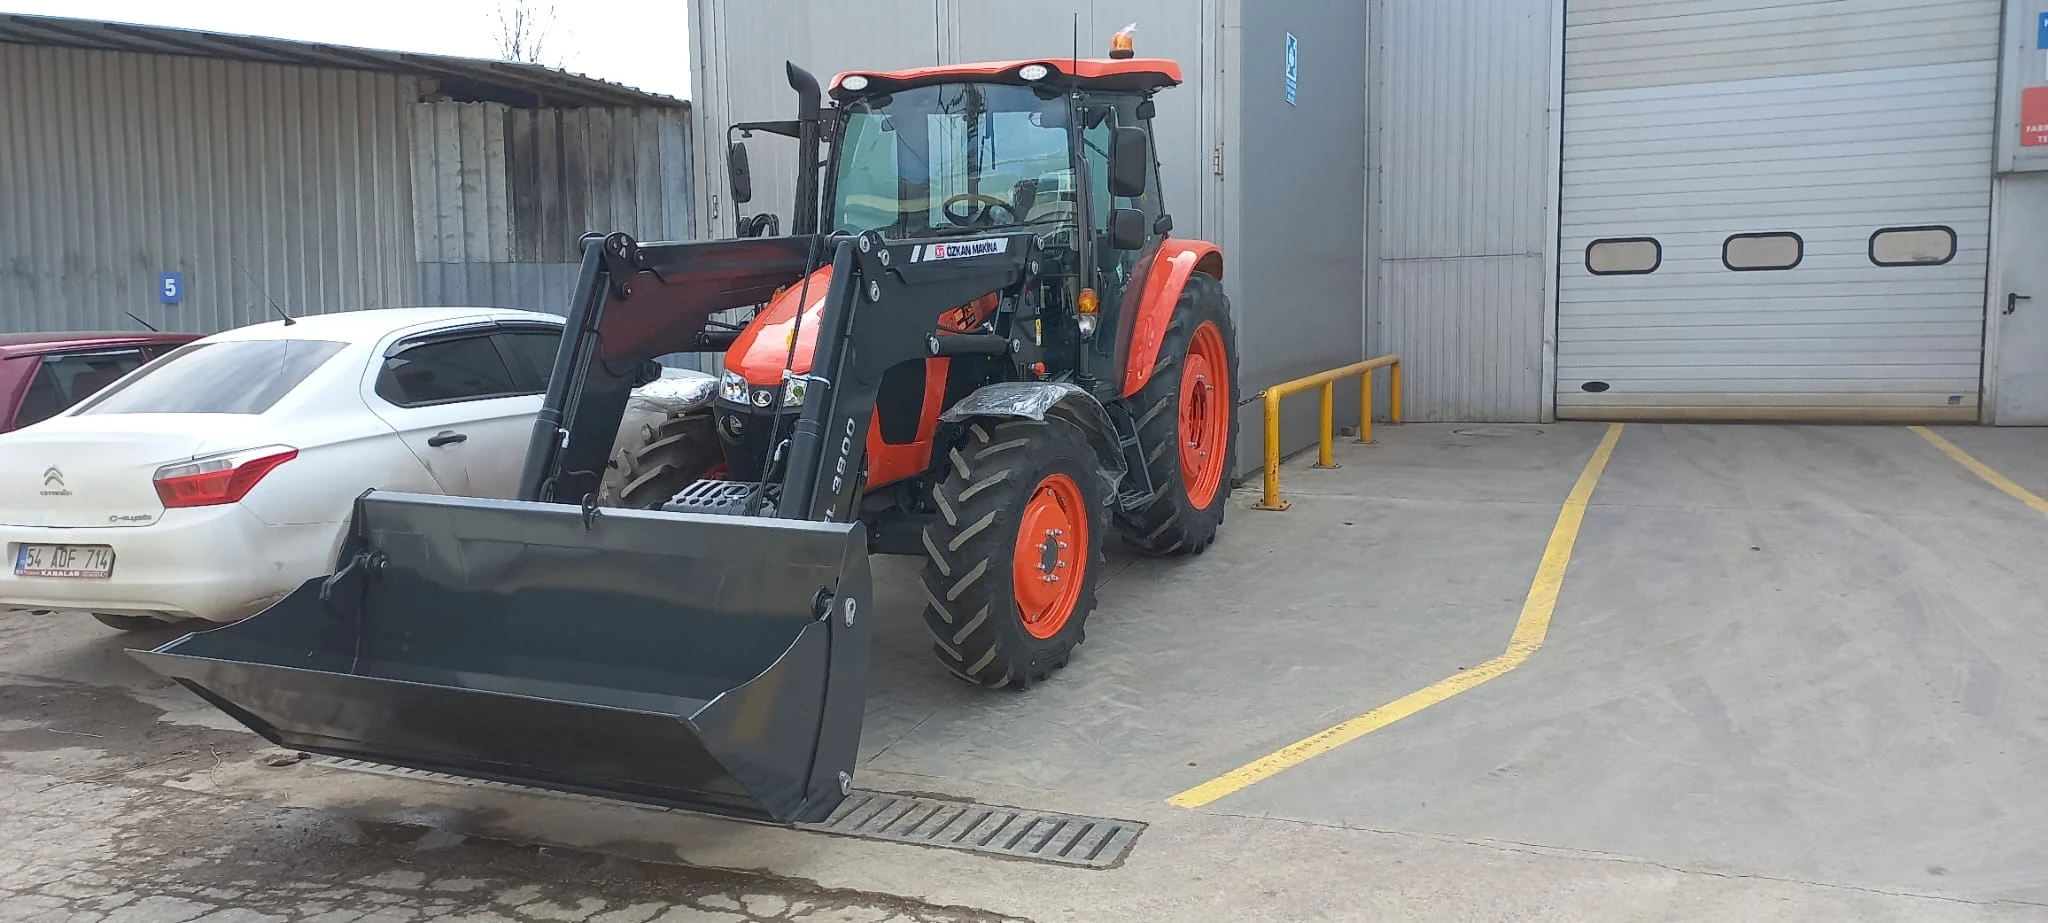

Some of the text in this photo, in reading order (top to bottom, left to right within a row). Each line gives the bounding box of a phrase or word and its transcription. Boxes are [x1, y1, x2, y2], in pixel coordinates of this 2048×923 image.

[165, 278, 176, 297] 5
[27, 548, 108, 569] 54 ADF 714
